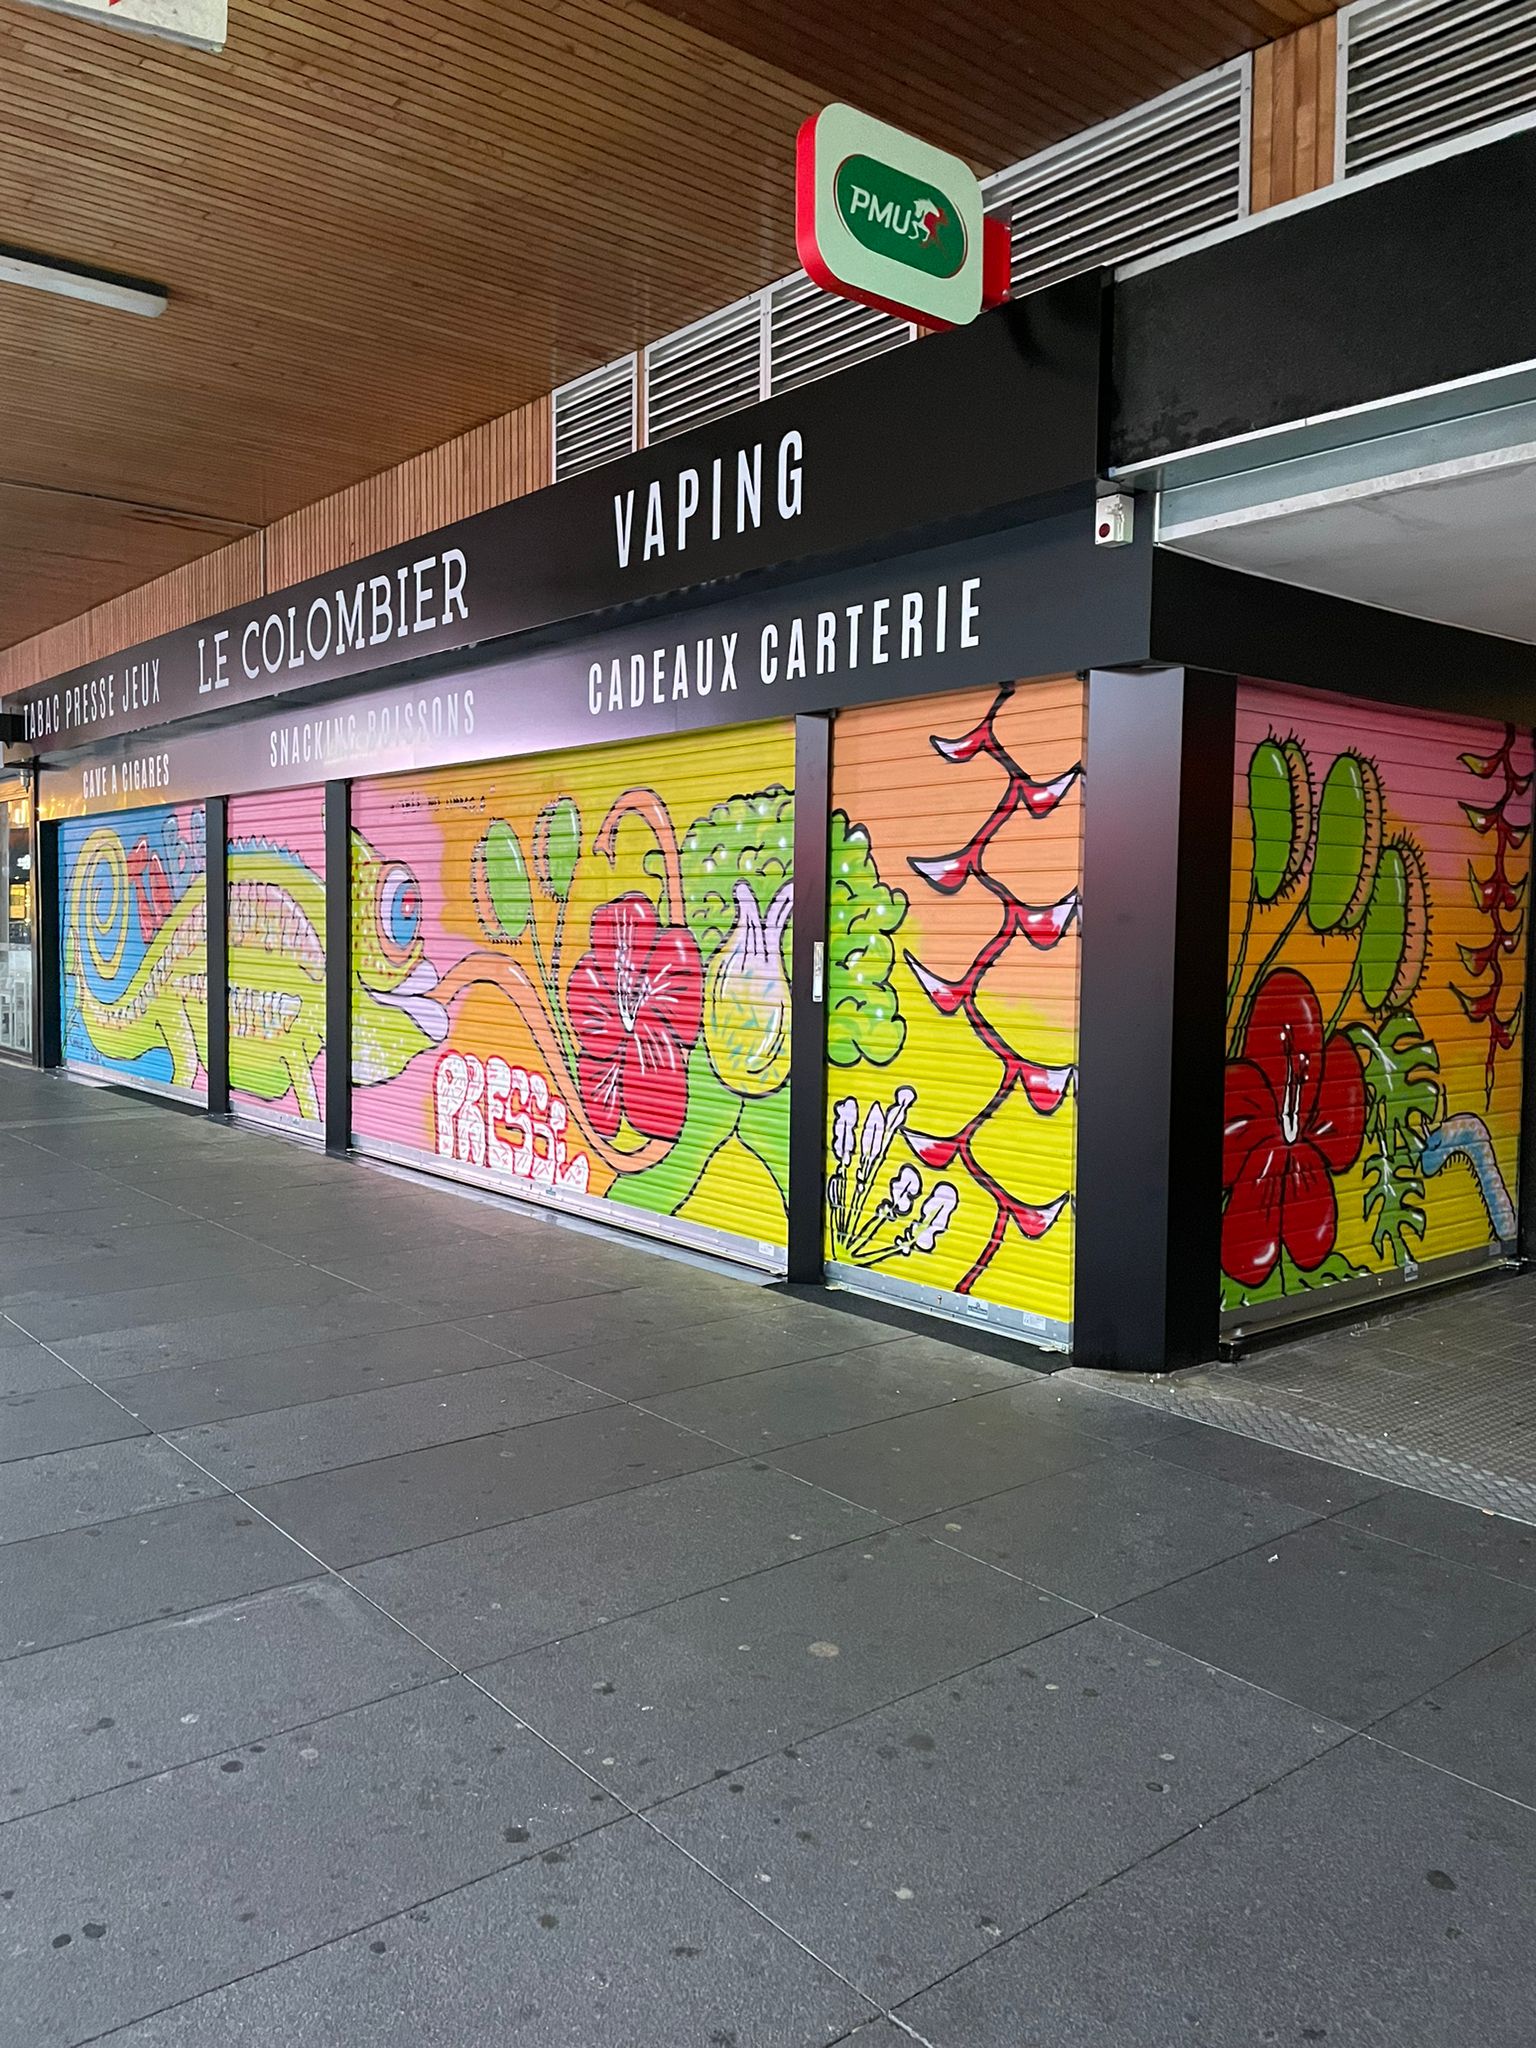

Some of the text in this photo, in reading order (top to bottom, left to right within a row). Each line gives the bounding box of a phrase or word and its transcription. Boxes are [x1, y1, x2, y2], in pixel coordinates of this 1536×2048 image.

[850, 184, 912, 235] PMU
[614, 430, 803, 568] VAPING
[198, 548, 469, 694] LE COLOMBIER
[588, 577, 981, 716] CADEAUX CARTERIE
[23, 658, 160, 741] TABAC PRESSE JEUX
[269, 689, 475, 768] SNACKING BOISSONS
[82, 753, 170, 799] CAVE A CIGARES
